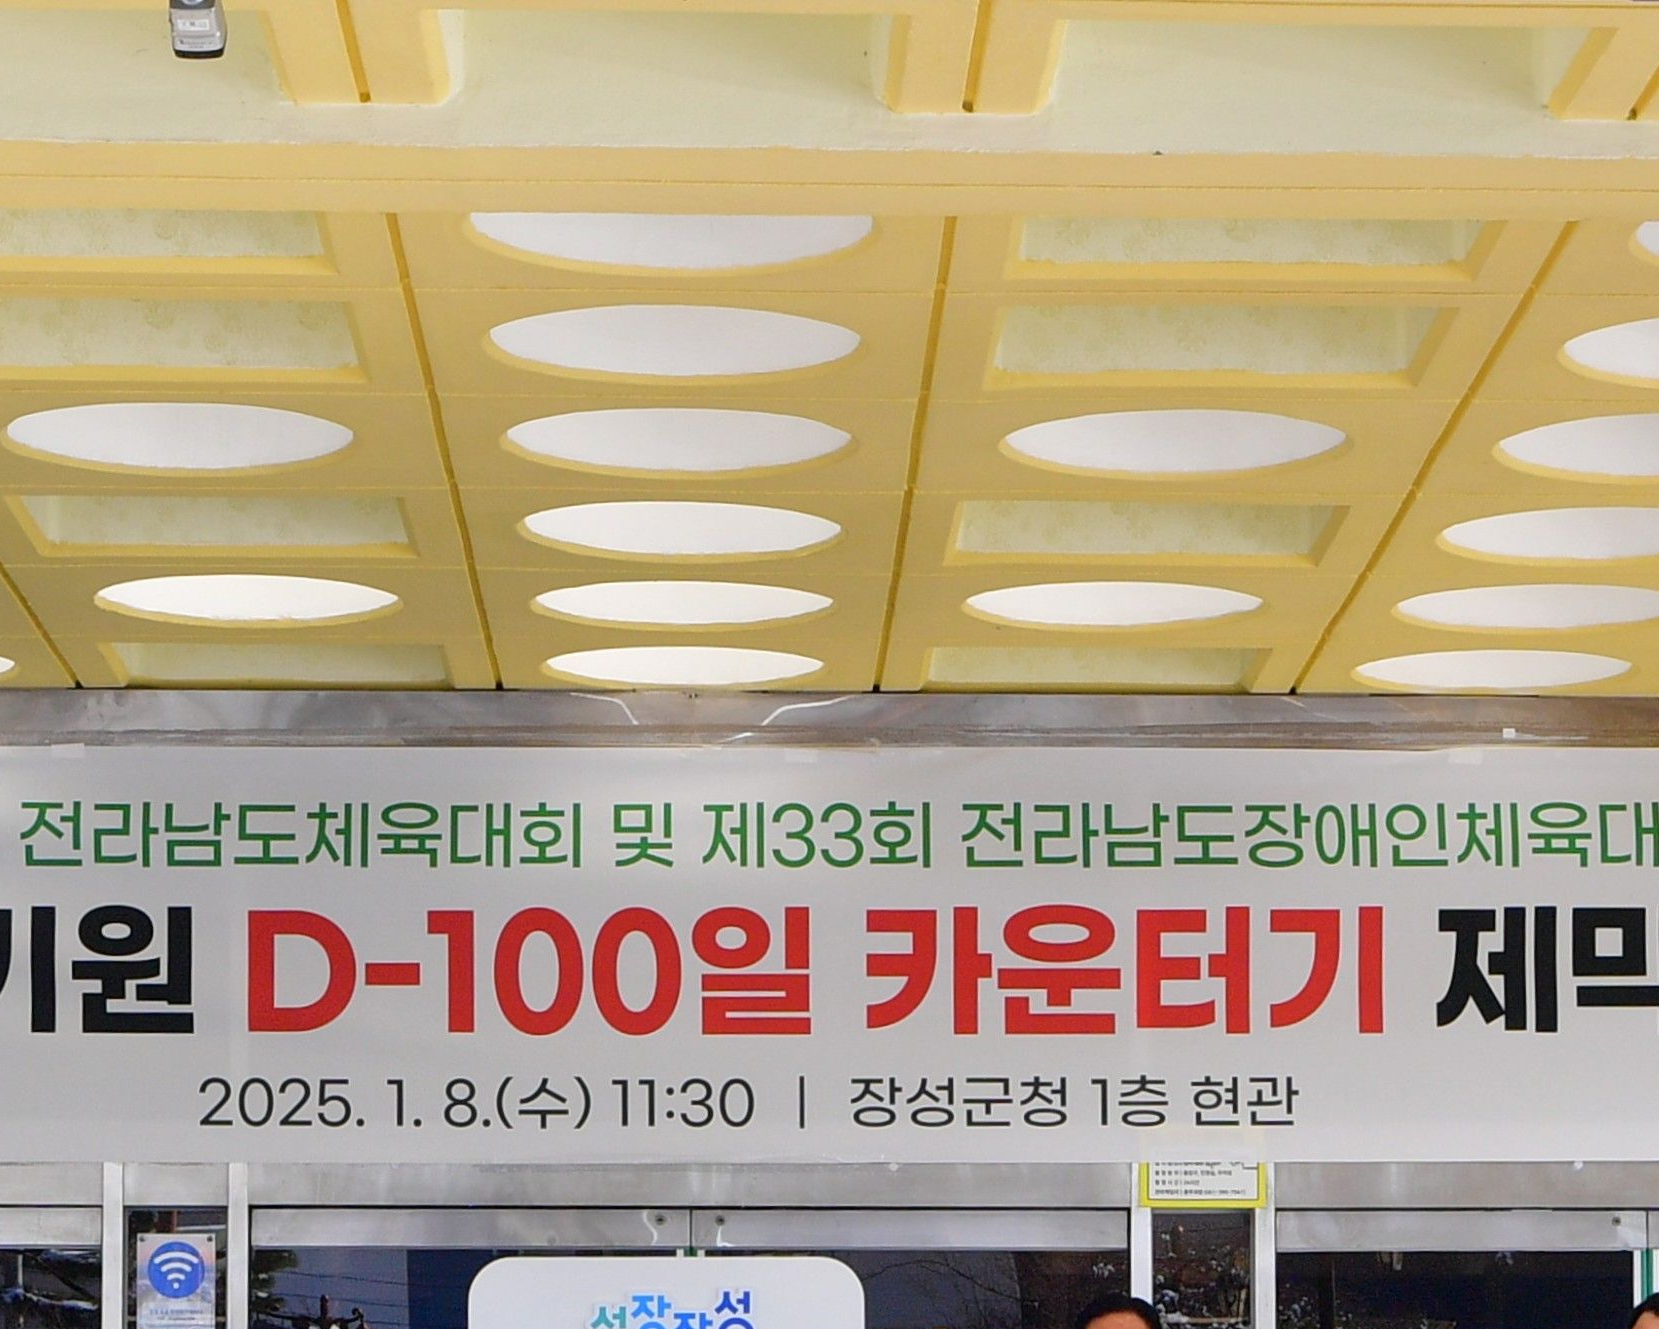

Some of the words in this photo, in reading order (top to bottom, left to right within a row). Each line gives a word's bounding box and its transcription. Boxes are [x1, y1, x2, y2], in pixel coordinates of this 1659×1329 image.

[19, 799, 581, 868] 전라남도체육대회
[613, 801, 674, 868] 및
[702, 799, 931, 869] 제33회
[247, 905, 811, 1035] D-100일
[866, 904, 1384, 1034] 카운터기
[198, 1077, 364, 1127] 2025.
[386, 1078, 422, 1127] 1.
[443, 1076, 590, 1130] 8.(수)
[611, 1077, 754, 1127] 11:30
[850, 1075, 1068, 1128] 장성군청
[1089, 1074, 1168, 1127] 1층
[1190, 1074, 1299, 1127] 현관
